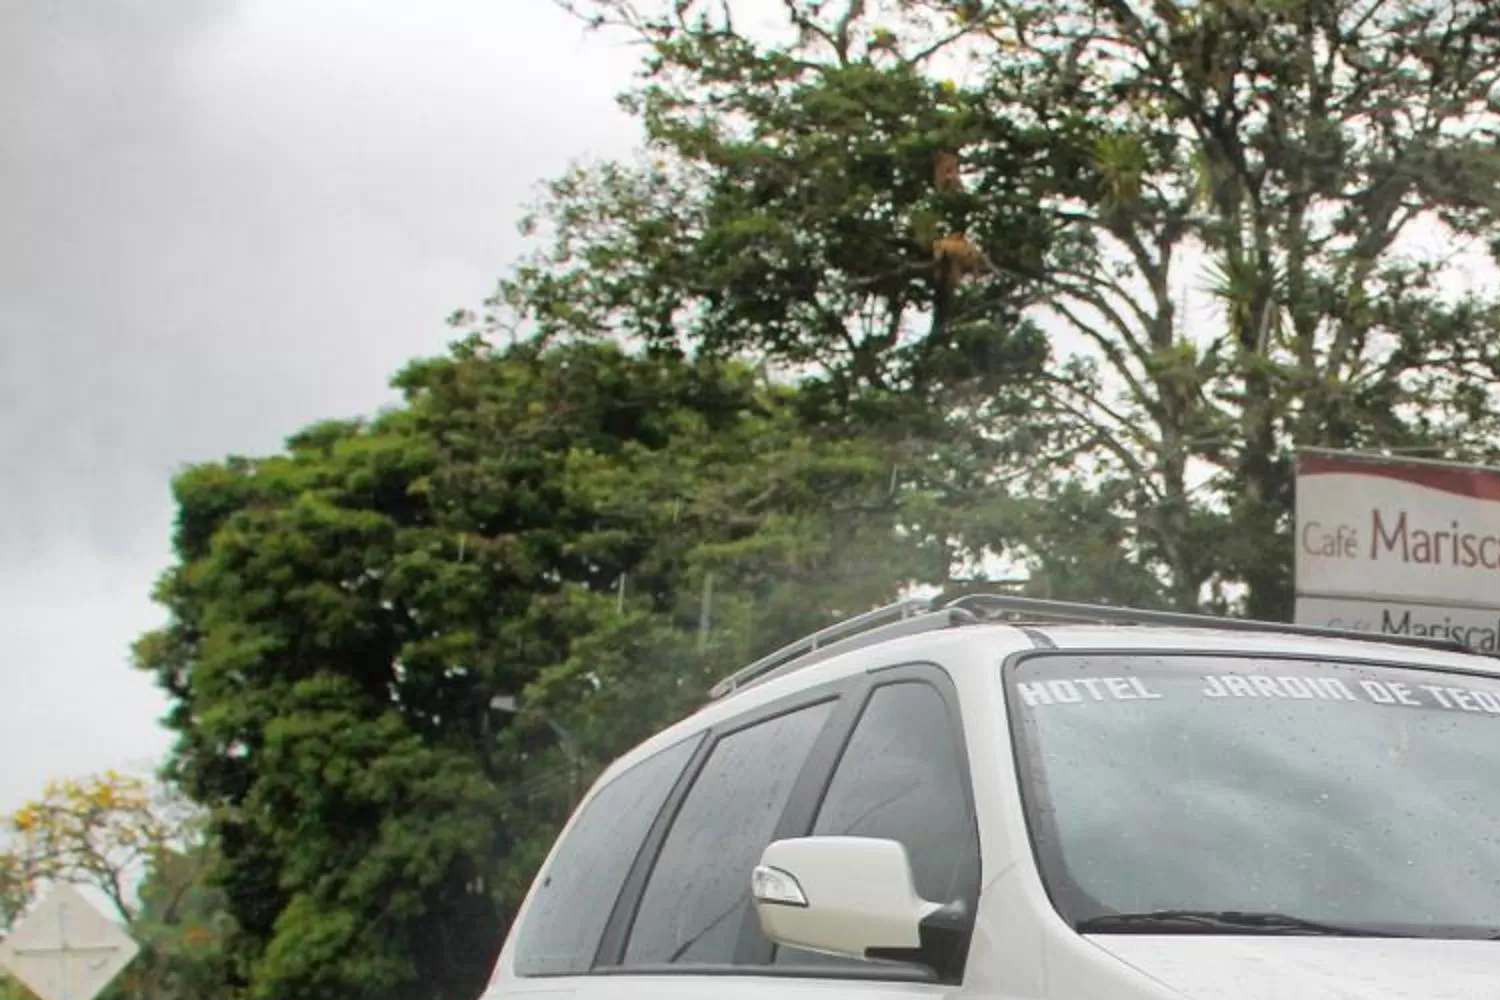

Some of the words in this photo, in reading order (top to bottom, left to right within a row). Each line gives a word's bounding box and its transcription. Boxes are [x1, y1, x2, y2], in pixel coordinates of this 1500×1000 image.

[1302, 522, 1358, 559] Café
[1017, 676, 1163, 706] HOTEL
[1202, 675, 1356, 701] JARDIN
[1360, 680, 1422, 706] DE
